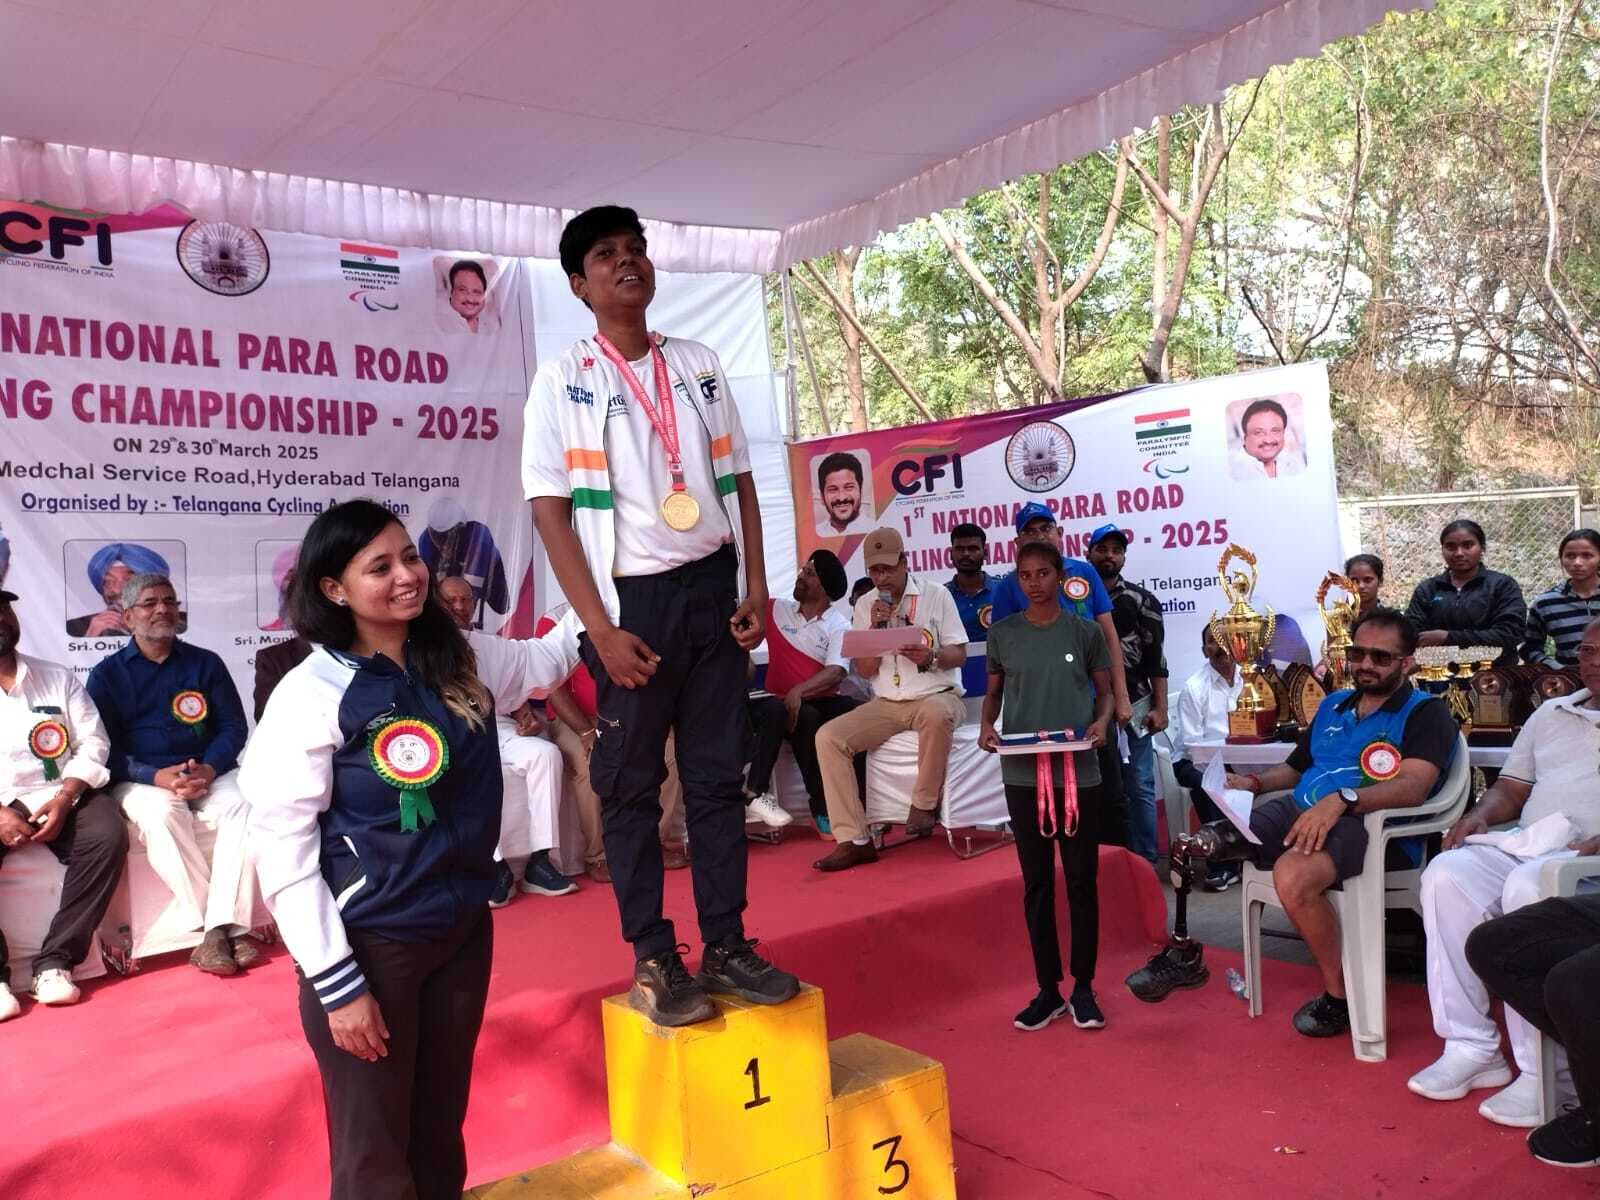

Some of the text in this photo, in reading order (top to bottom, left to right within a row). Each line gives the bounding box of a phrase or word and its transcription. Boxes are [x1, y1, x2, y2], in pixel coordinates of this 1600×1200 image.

[0, 211, 112, 265] CFI
[1, 312, 449, 384] NATIONAL PARA ROAD
[72, 383, 378, 436] CHAMPIONSHIP
[417, 404, 499, 440] 2025
[113, 438, 142, 453] ON
[220, 443, 271, 458] March
[277, 445, 319, 460] 2025
[1137, 434, 1191, 446] PARALYMPIC
[1139, 441, 1190, 452] COMMITTEE
[103, 463, 186, 483] Service
[372, 472, 460, 491] Telangana
[891, 453, 963, 496] CFI
[21, 492, 120, 514] Organised
[127, 494, 148, 515] by
[172, 496, 262, 516] Telangana
[267, 497, 323, 517] Cycling
[932, 501, 1025, 534] NATIONA
[1046, 493, 1107, 521] PARA
[1117, 483, 1184, 514] ROAD
[1161, 518, 1228, 549] 2025
[744, 1057, 771, 1110] 1
[872, 1135, 911, 1196] 3
